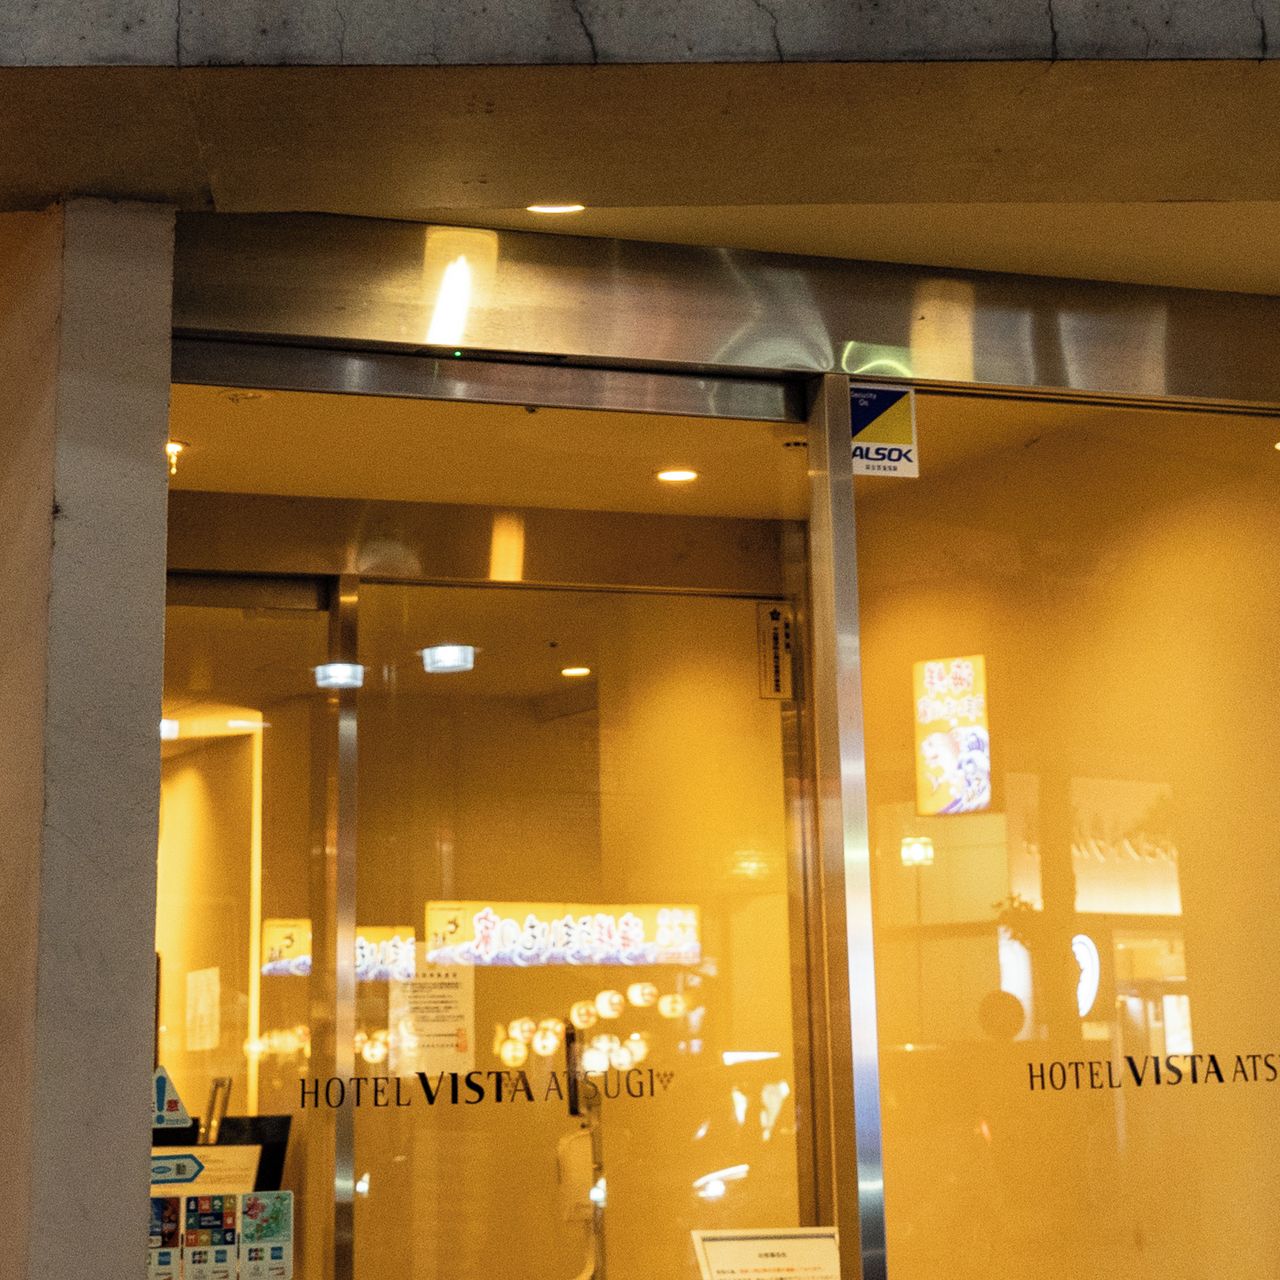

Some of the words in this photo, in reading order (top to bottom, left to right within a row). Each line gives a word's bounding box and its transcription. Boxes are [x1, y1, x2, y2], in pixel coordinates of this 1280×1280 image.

[852, 445, 913, 463] ALSOK
[300, 1076, 411, 1109] HOTEL
[416, 1070, 535, 1105] VISTA
[1028, 1060, 1121, 1091] HOTEL
[1124, 1053, 1225, 1087] VISTA
